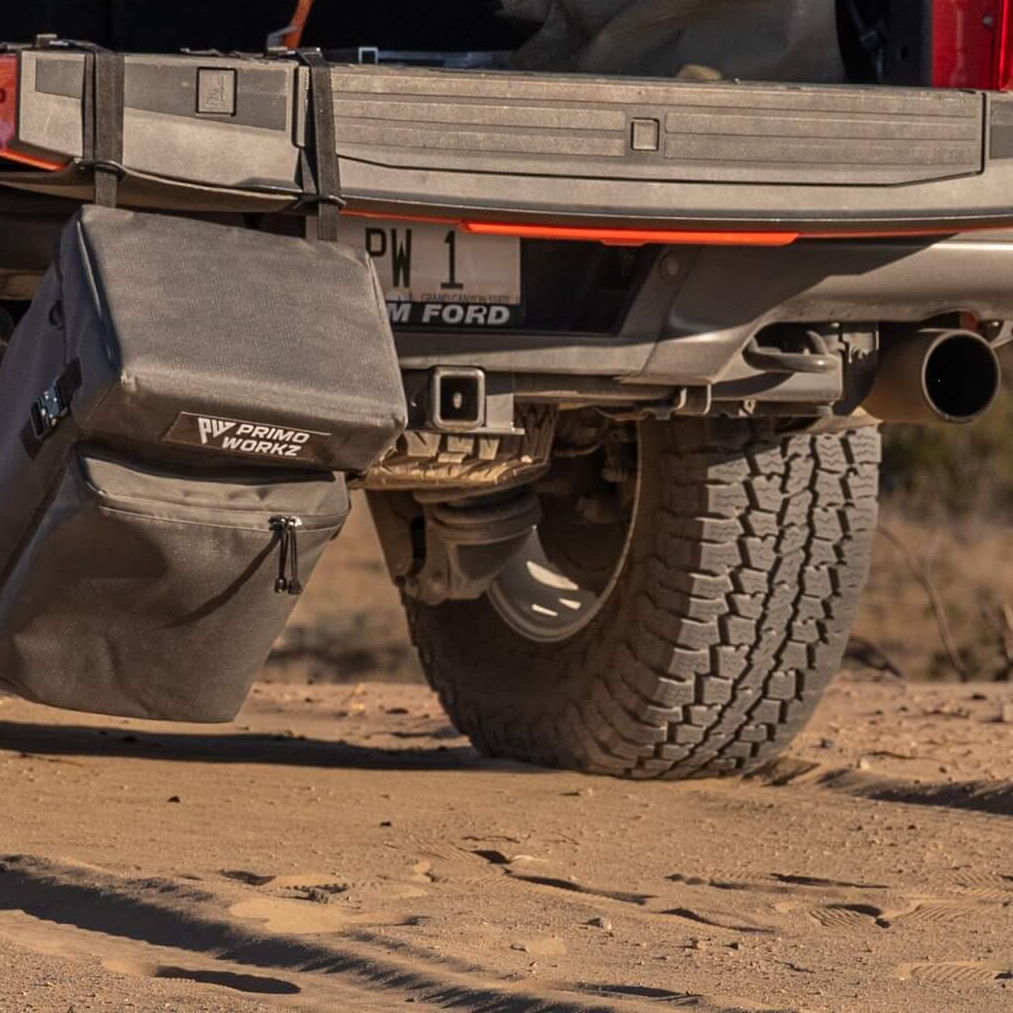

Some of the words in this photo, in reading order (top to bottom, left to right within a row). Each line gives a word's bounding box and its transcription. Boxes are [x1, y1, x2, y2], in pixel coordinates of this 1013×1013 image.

[440, 230, 464, 289] 1
[420, 292, 451, 302] GRAND
[421, 304, 511, 324] FORD
[236, 424, 310, 444] PRIMO
[221, 436, 302, 457] WORKZ
